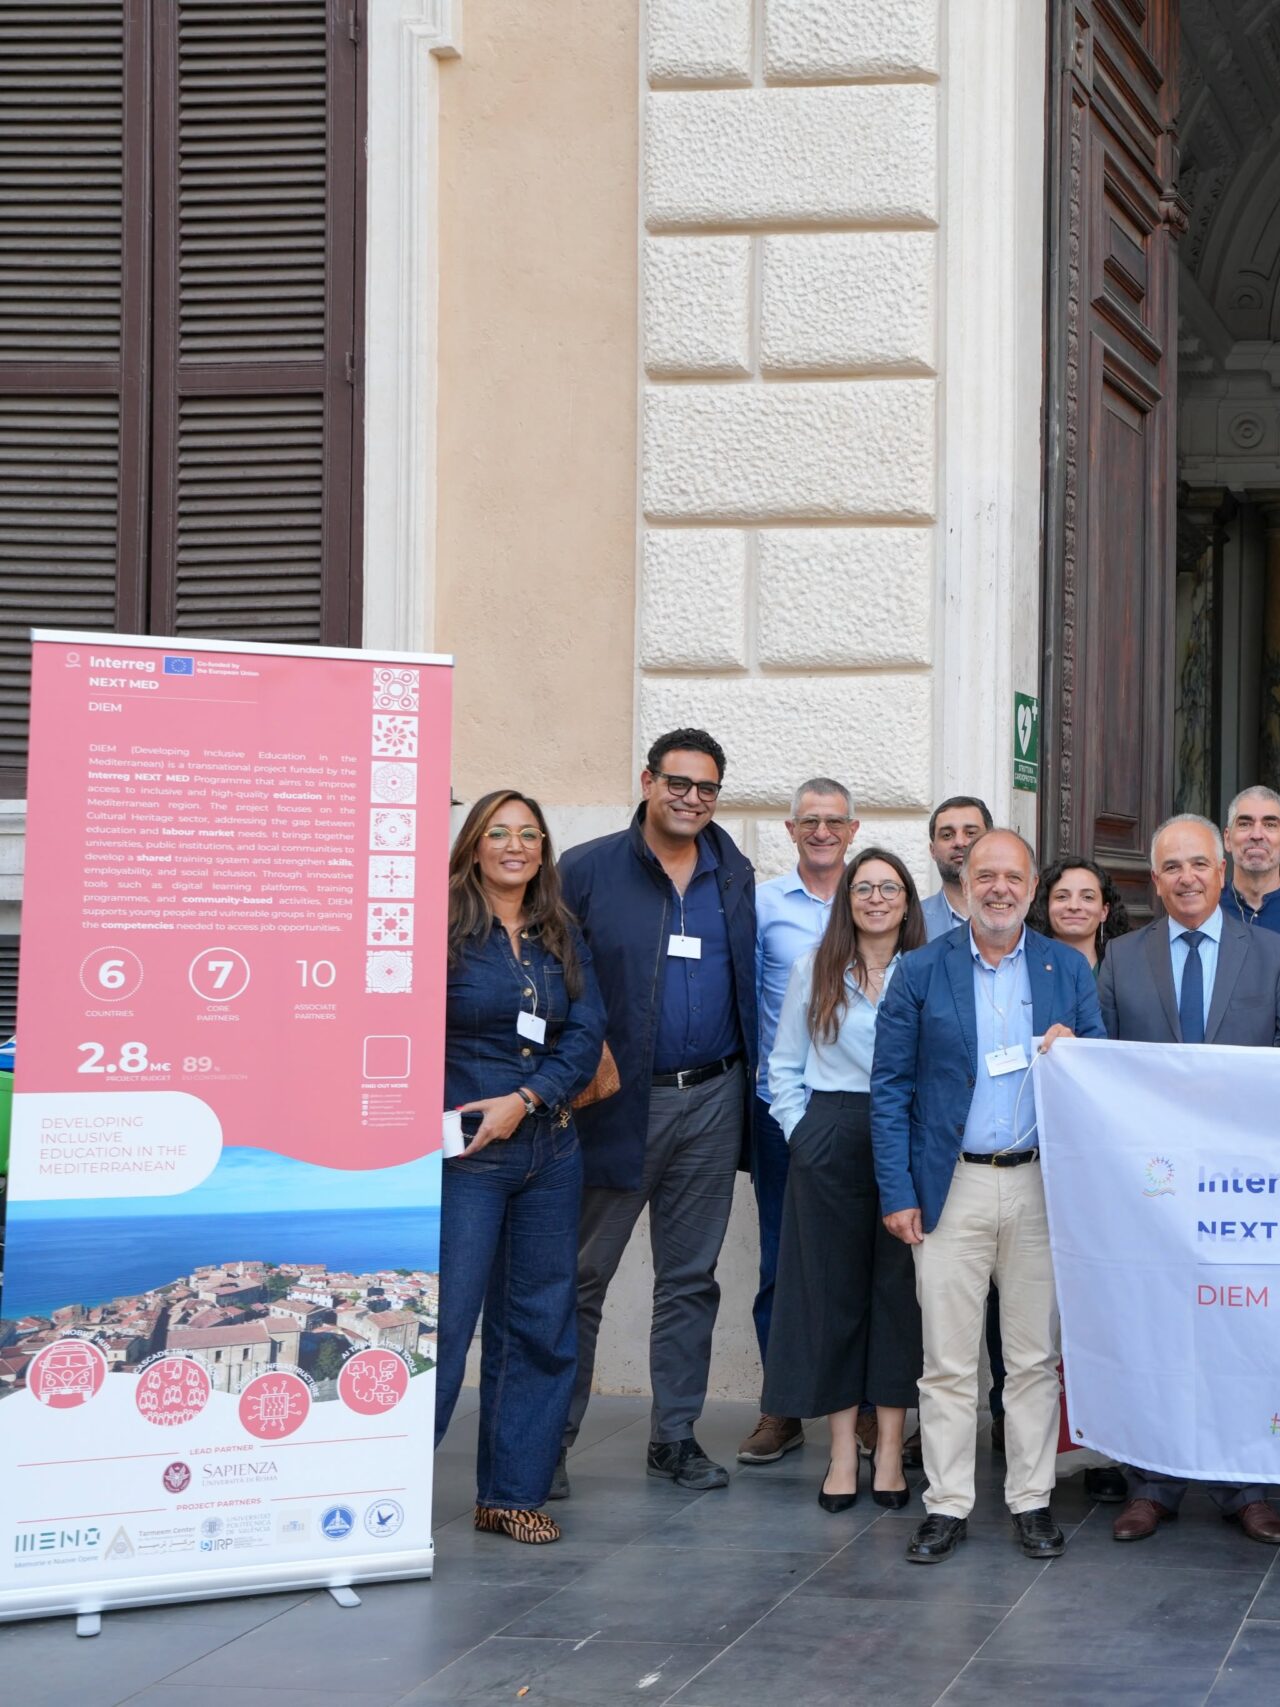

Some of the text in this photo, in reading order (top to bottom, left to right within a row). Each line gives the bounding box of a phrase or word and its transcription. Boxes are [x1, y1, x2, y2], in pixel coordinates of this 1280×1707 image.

[90, 656, 155, 672] Interreg
[197, 660, 230, 669] Co-funded
[89, 677, 159, 690] NEXT MED
[88, 702, 122, 712] DIEM
[89, 743, 116, 752] DIEM
[203, 748, 245, 758] Inclusive
[258, 750, 305, 760] Education
[319, 753, 327, 761] in
[341, 754, 356, 762] the
[167, 760, 175, 768] is
[187, 761, 250, 771] transnational
[253, 763, 286, 774] project
[290, 765, 323, 774] funded
[326, 766, 337, 776] by
[340, 767, 356, 775] the
[87, 770, 356, 790] Interreg NEXT MED Programme that aims to improve
[125, 785, 135, 793] to
[140, 786, 182, 795] inclusive
[187, 787, 206, 796] and
[211, 788, 268, 800] high-quality
[272, 790, 322, 800] education
[326, 792, 335, 800] in
[340, 793, 355, 801] the
[87, 797, 159, 808] Mediterranean
[210, 802, 227, 810] The
[235, 802, 268, 813] project
[276, 804, 312, 813] focuses
[339, 806, 355, 814] the
[86, 811, 126, 820] Cultural
[131, 812, 173, 823] Heritage
[214, 815, 266, 826] addressing
[271, 817, 287, 825] the
[291, 819, 310, 827] gap
[314, 818, 354, 827] between
[85, 824, 136, 834] education
[139, 826, 159, 834] and
[161, 827, 195, 836] labour
[198, 828, 234, 837] market
[272, 830, 278, 838] It
[282, 830, 311, 841] brings
[314, 831, 353, 842] together
[145, 840, 176, 850] public
[236, 842, 255, 851] and
[257, 843, 279, 851] local
[281, 844, 342, 853] communities
[84, 852, 124, 862] develop
[136, 853, 172, 862] shared
[174, 854, 212, 864] training
[215, 855, 249, 865] system
[252, 856, 270, 864] and
[273, 856, 325, 867] strengthen
[157, 867, 176, 875] and
[181, 868, 208, 876] social
[262, 870, 302, 880] Through
[307, 871, 353, 879] innovative
[83, 879, 108, 887] tools
[117, 880, 141, 888] such
[171, 881, 202, 891] digital
[212, 882, 251, 892] learning
[316, 884, 353, 894] training
[156, 894, 176, 902] and
[181, 894, 272, 906] community-based
[328, 897, 352, 906] DIEM
[82, 906, 127, 917] supports
[128, 909, 160, 917] young
[162, 908, 196, 918] people
[198, 908, 217, 916] and
[219, 909, 269, 917] vulnerable
[271, 911, 304, 920] groups
[317, 910, 352, 920] gaining
[82, 920, 99, 928] the
[100, 920, 174, 931] competencies
[176, 921, 213, 930] needed
[215, 922, 225, 930] to
[260, 923, 275, 932] job
[99, 960, 125, 988] 6
[208, 961, 234, 988] 7
[296, 960, 336, 987] 10
[182, 1056, 212, 1072] 89
[42, 1116, 144, 1129] DEVELOPING
[40, 1132, 122, 1144] INCLUSIVE
[40, 1145, 187, 1159] EDUCATION IN THE
[40, 1161, 175, 1174] MEDITERRANEAN
[1198, 1221, 1278, 1242] NEXT
[1198, 1285, 1268, 1307] DIEM
[94, 1336, 111, 1350] HUB
[214, 1445, 253, 1453] PARTNER
[203, 1461, 278, 1478] SAPIENZA
[176, 1498, 261, 1511] PROJECT PARTNERS
[214, 1538, 233, 1550] IRP
